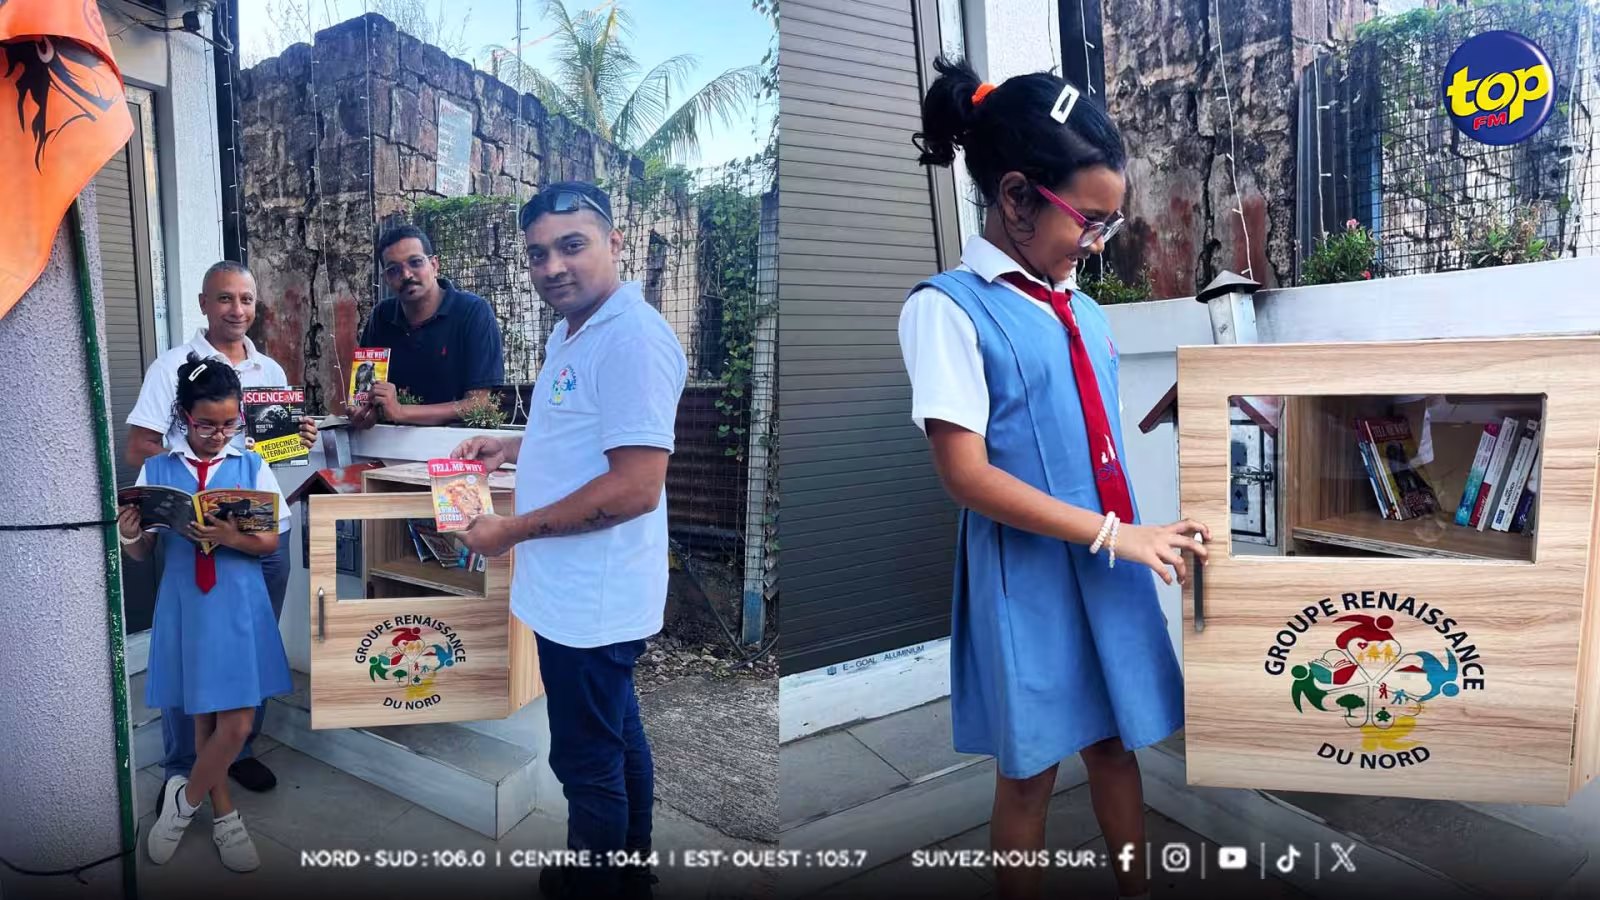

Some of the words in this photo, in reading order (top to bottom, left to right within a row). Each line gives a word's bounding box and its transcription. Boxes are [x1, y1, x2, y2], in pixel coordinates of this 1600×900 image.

[246, 391, 284, 403] SCIENCE
[289, 391, 304, 402] VIE
[431, 463, 451, 473] TELL
[451, 463, 465, 472] ME
[464, 463, 483, 472] WHY
[354, 619, 393, 664] GROUPE
[394, 614, 467, 663] RENAISSANCE
[1264, 597, 1339, 676] GROUPE
[1341, 591, 1485, 691] RENAISSANCE
[382, 697, 402, 710] DU
[405, 694, 442, 710] NORD
[1316, 742, 1354, 766] DU
[1360, 746, 1431, 770] NORD
